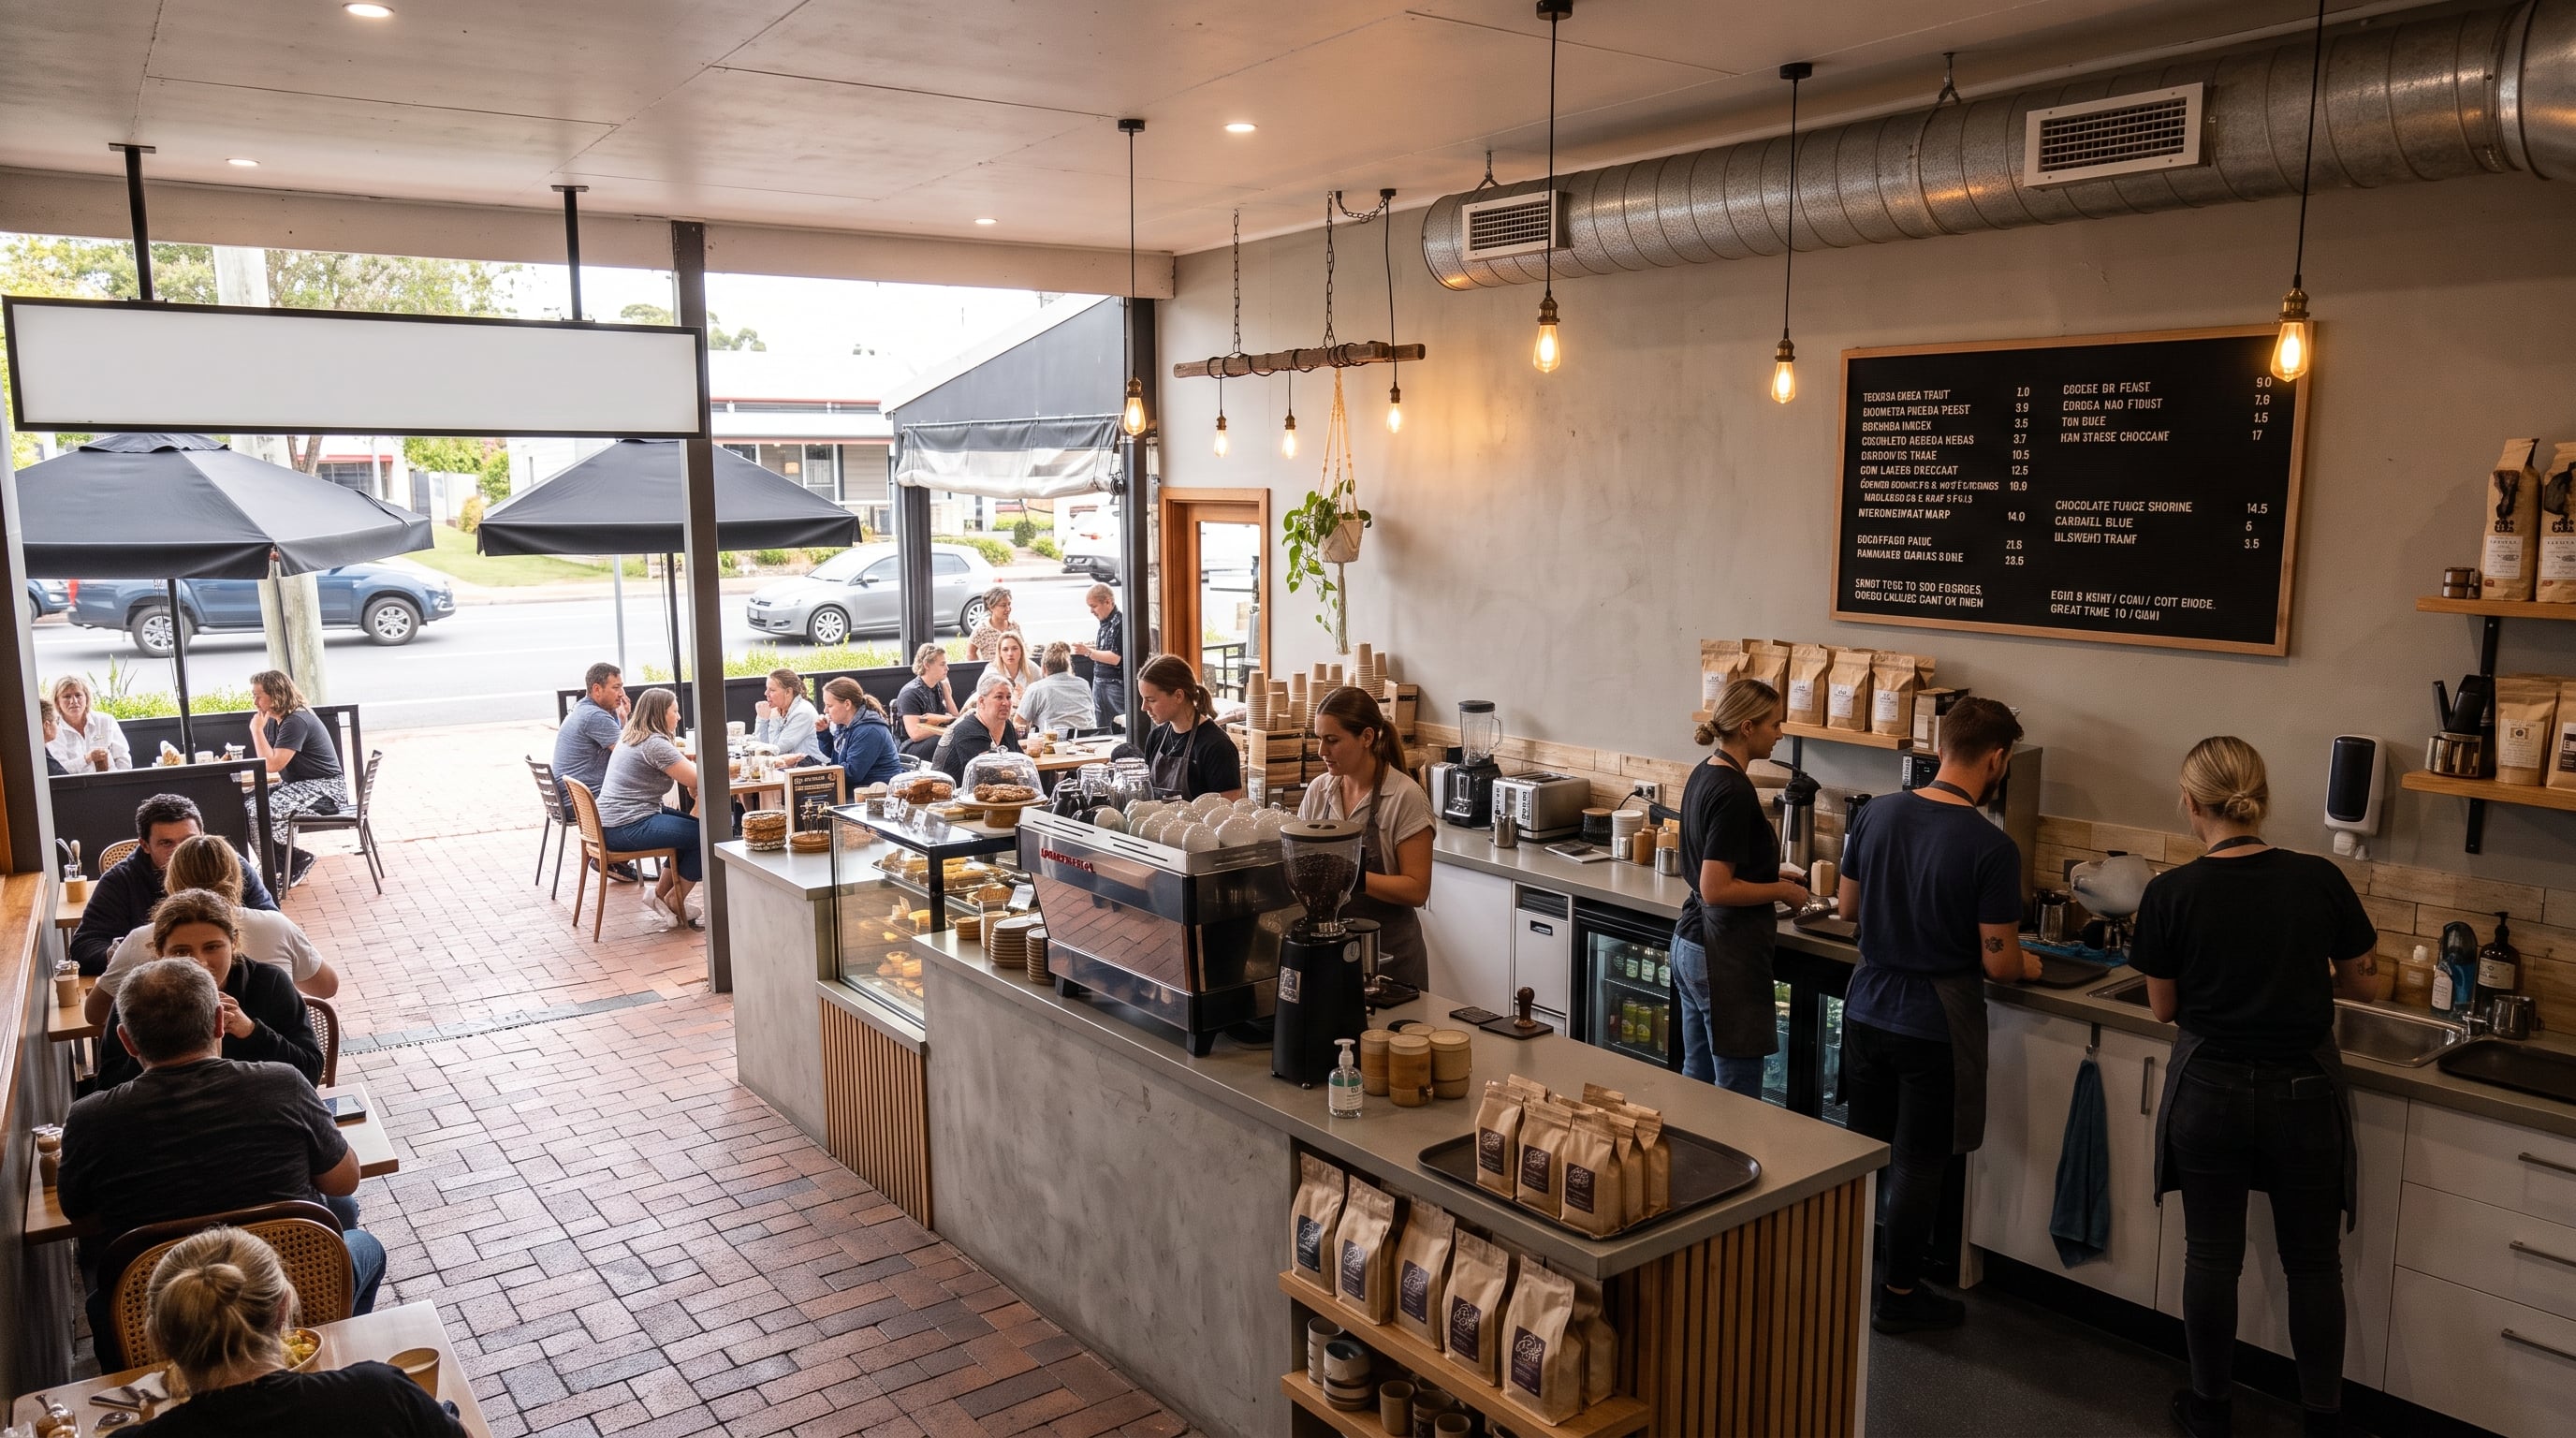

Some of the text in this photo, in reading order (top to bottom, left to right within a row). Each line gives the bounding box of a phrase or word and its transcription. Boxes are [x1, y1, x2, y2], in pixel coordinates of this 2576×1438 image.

[2015, 403, 2028, 412] 3.9
[2013, 434, 2027, 444] 3.7
[2252, 431, 2262, 440] 17
[2012, 450, 2029, 460] 10.5
[2012, 465, 2028, 476] 12.5
[2056, 501, 2110, 510] CHOCOLATE
[2148, 502, 2192, 512] SHORINE
[2247, 503, 2268, 514] 14.5
[2008, 512, 2025, 521] 14.0
[2106, 518, 2133, 528] BLUE
[2245, 538, 2260, 549] 3.5
[1906, 581, 1916, 591] TO
[2051, 604, 2082, 615] GREAT
